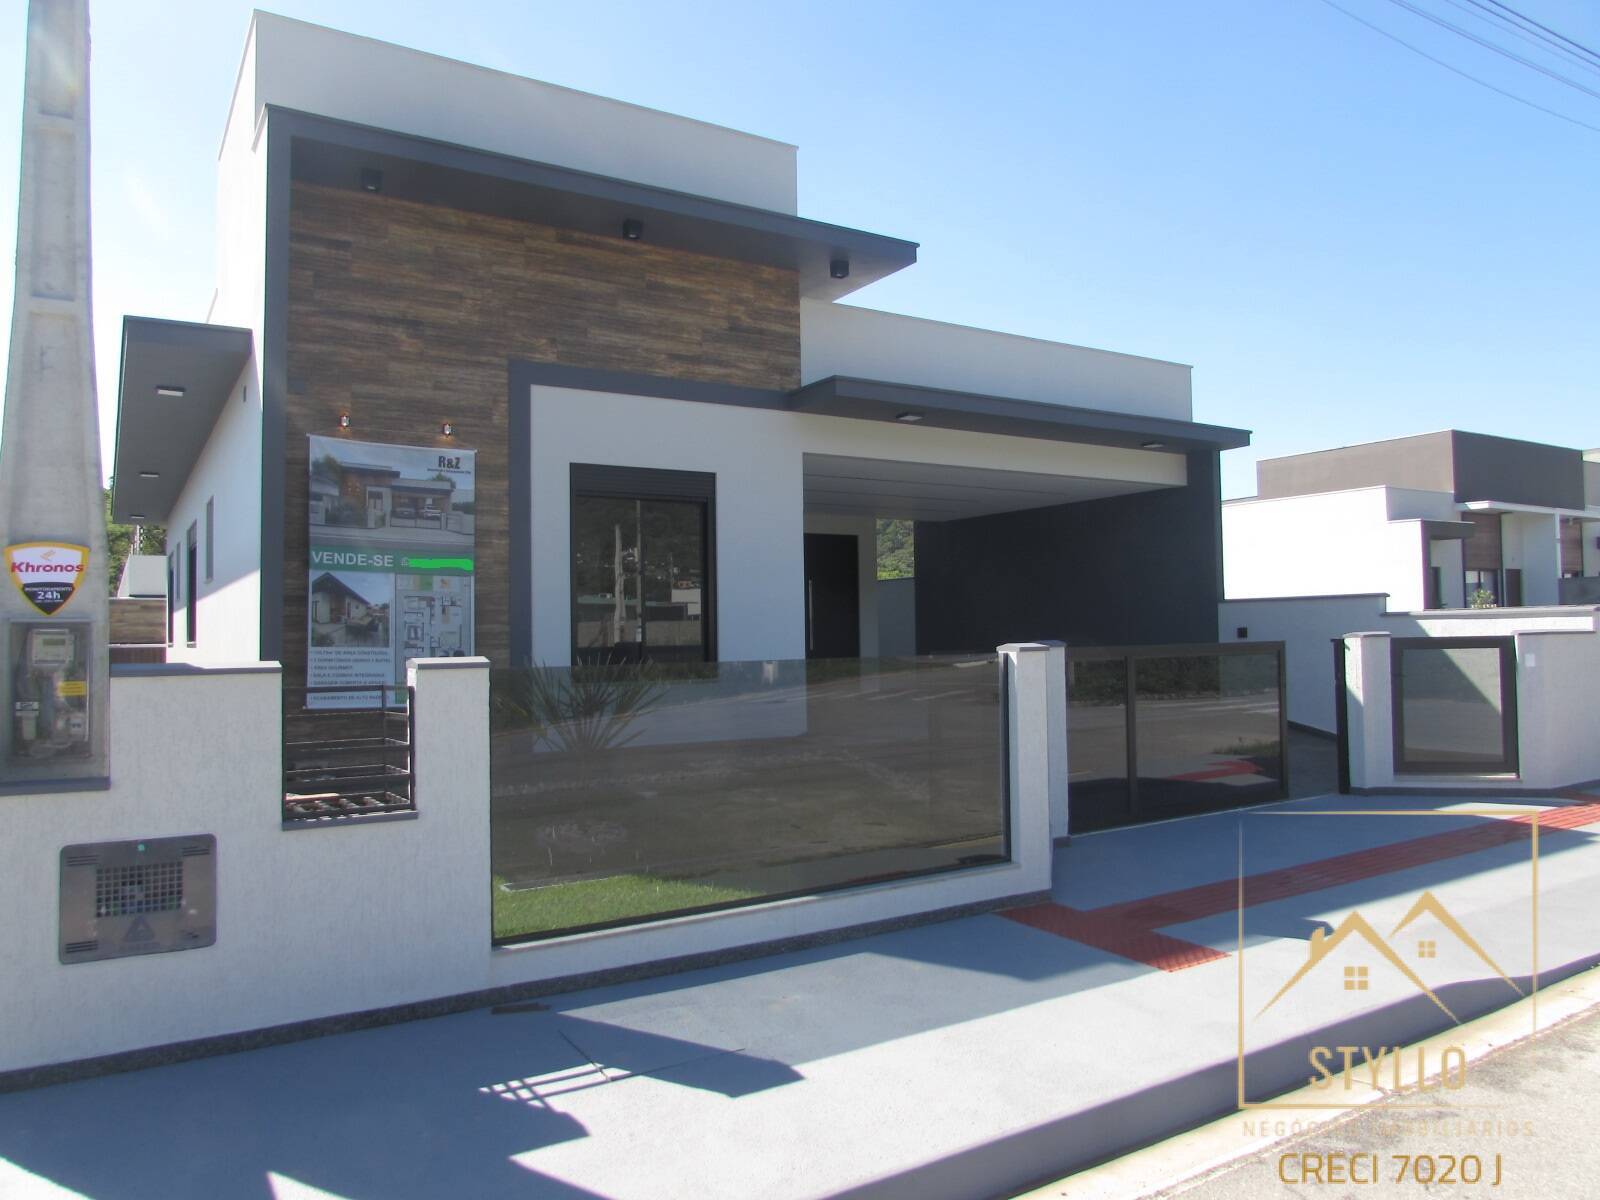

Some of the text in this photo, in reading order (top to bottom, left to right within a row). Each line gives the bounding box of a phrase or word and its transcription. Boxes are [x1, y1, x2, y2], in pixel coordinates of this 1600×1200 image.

[438, 455, 461, 469] R&Z
[311, 551, 394, 567] VENDE-SE
[11, 562, 84, 573] Khronos
[37, 592, 61, 600] 24h
